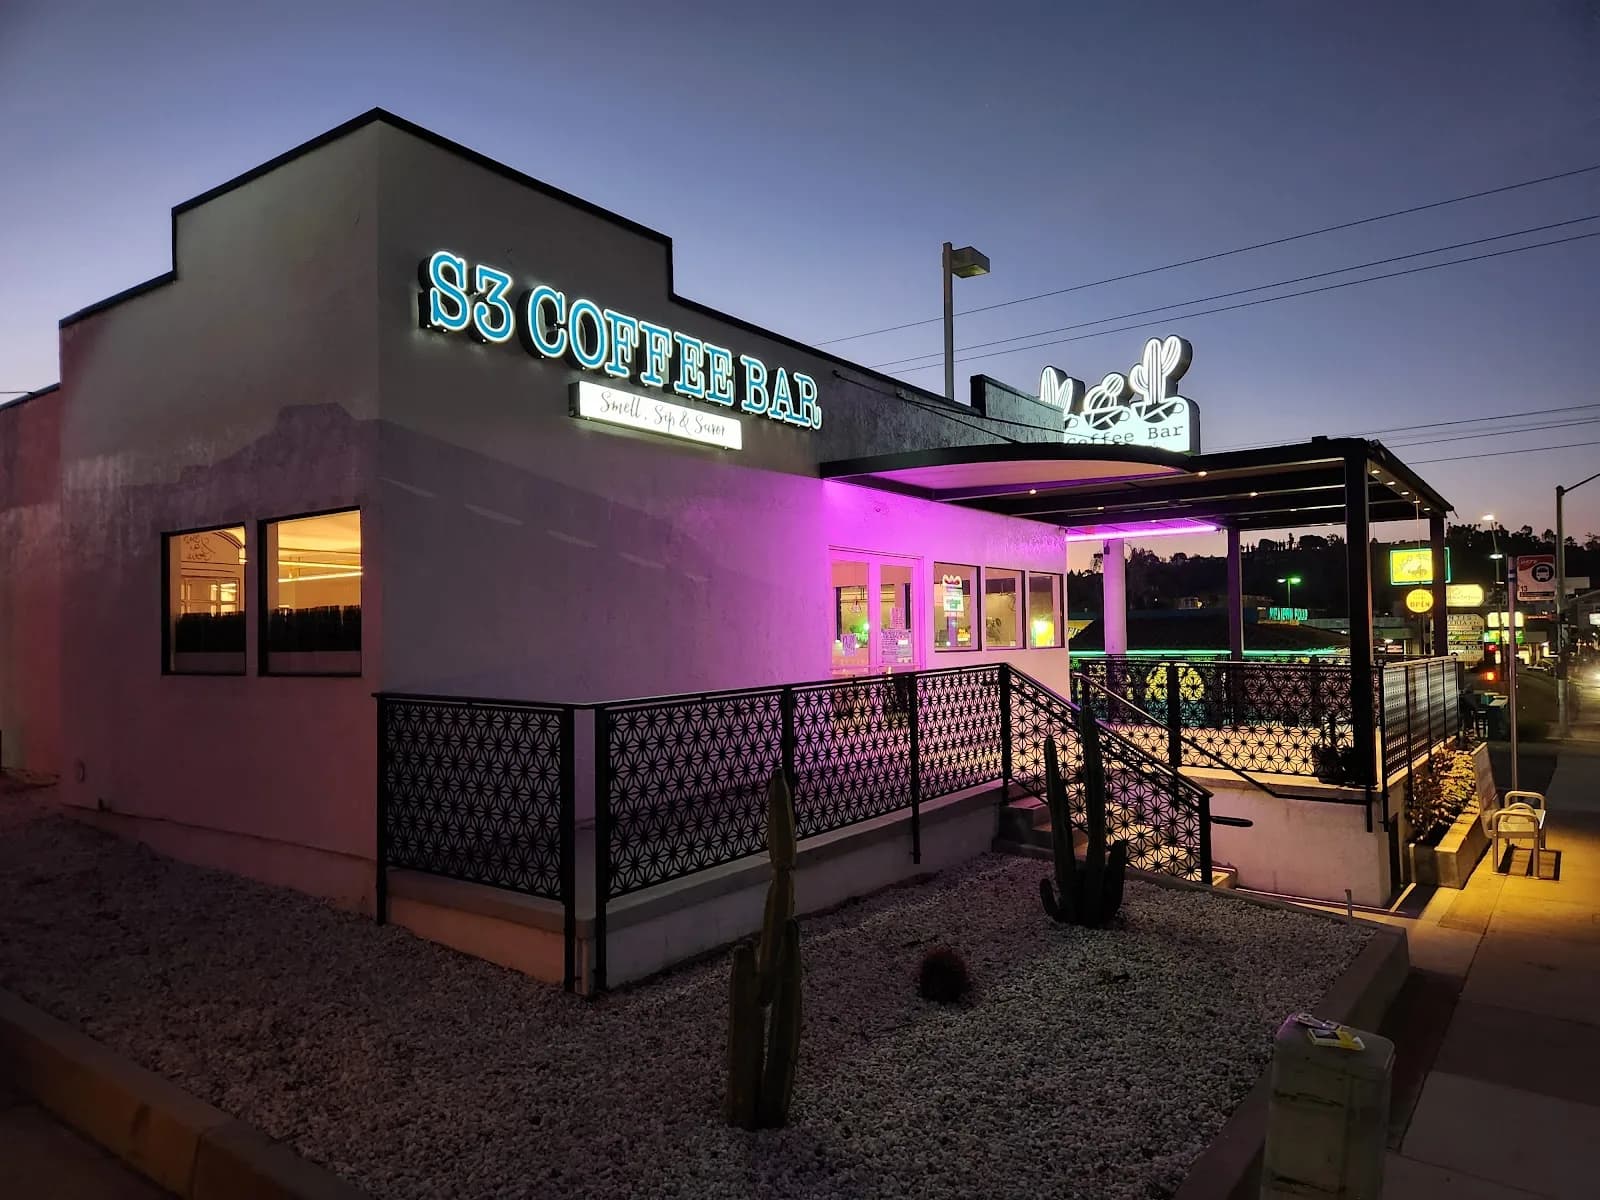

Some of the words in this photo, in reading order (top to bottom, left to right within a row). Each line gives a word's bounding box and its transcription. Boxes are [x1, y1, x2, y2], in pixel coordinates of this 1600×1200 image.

[428, 250, 514, 343] S3
[526, 284, 735, 407] COFFEE
[739, 354, 823, 430] BAR
[653, 405, 676, 433] Sip
[679, 411, 692, 435] &
[694, 415, 726, 437] Savor
[1147, 425, 1184, 440] Bar
